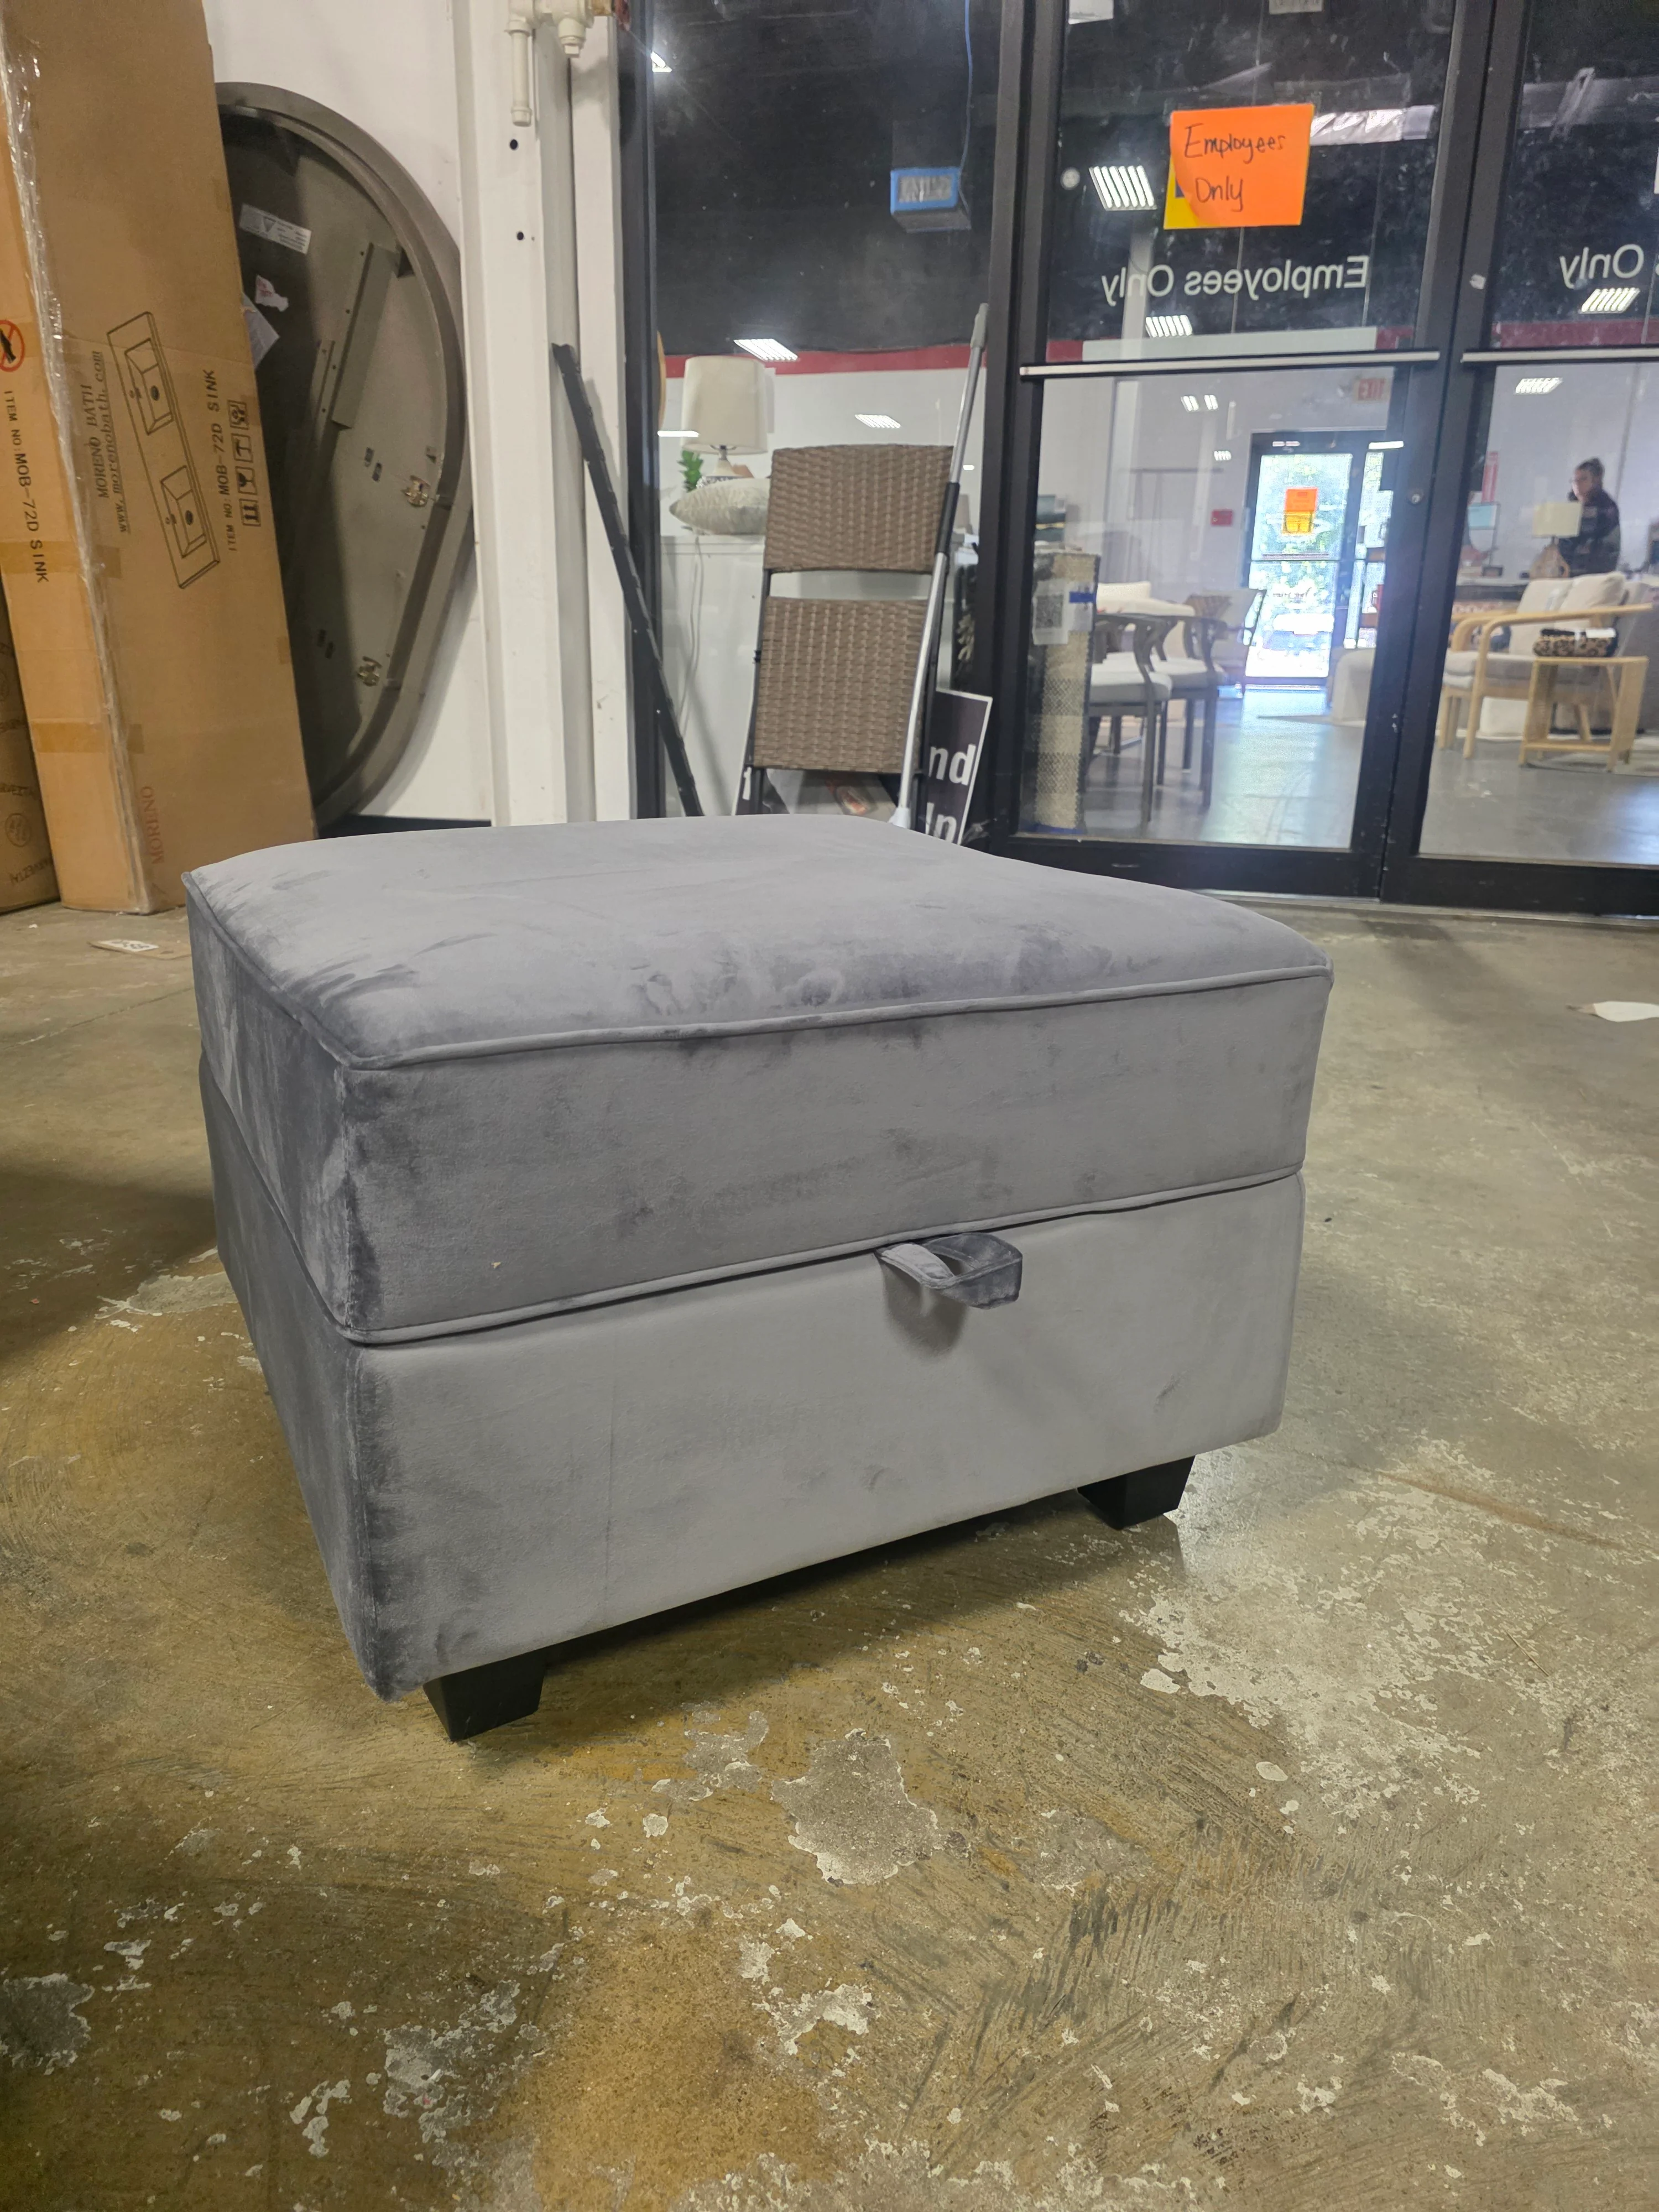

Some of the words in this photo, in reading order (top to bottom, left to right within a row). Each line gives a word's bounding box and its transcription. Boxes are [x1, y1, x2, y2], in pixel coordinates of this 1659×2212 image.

[1184, 122, 1286, 164] Employees
[1195, 175, 1244, 213] Only
[202, 369, 220, 413] SINK
[4, 390, 18, 422] ITEM
[30, 539, 49, 583] SINK
[88, 436, 110, 499] MORENO
[225, 524, 237, 551] ITEM
